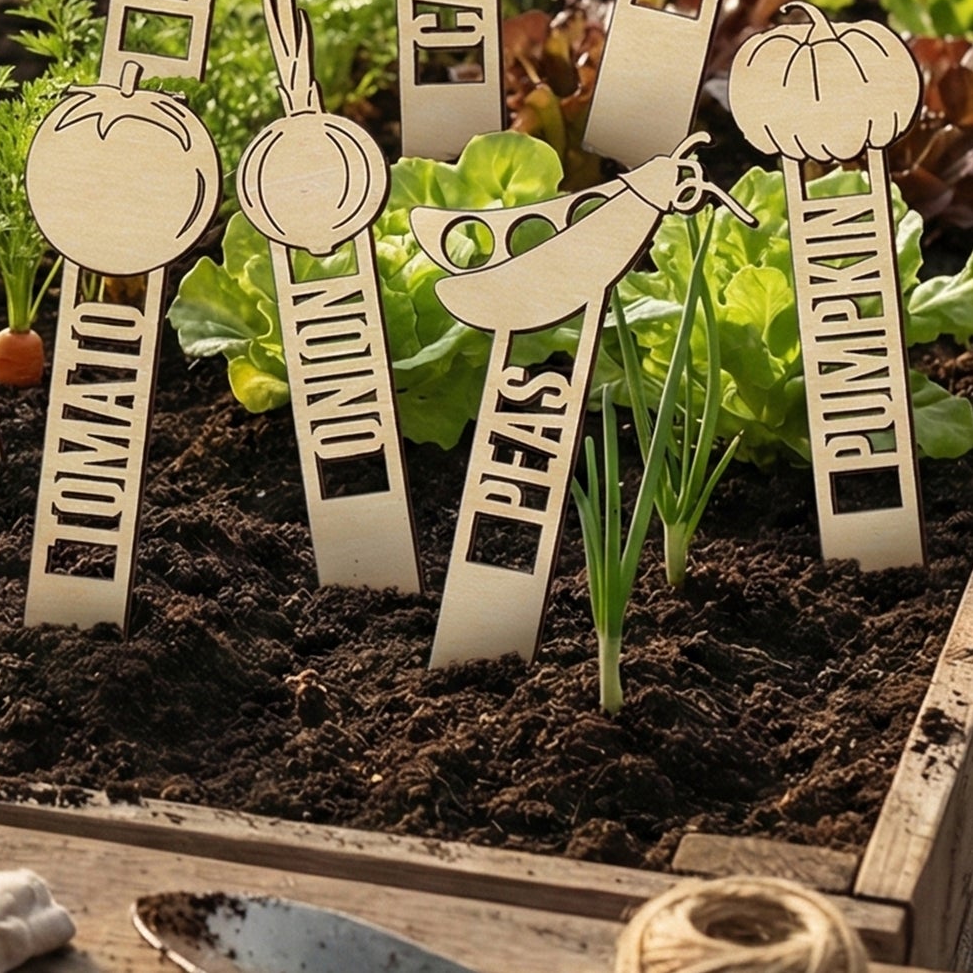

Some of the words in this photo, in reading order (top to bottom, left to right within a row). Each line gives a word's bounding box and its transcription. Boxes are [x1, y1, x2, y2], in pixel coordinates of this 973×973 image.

[50, 302, 145, 547] TOMATO
[290, 274, 384, 458] ONION
[802, 193, 898, 472] PUMPKIN
[474, 365, 571, 525] PEAS
